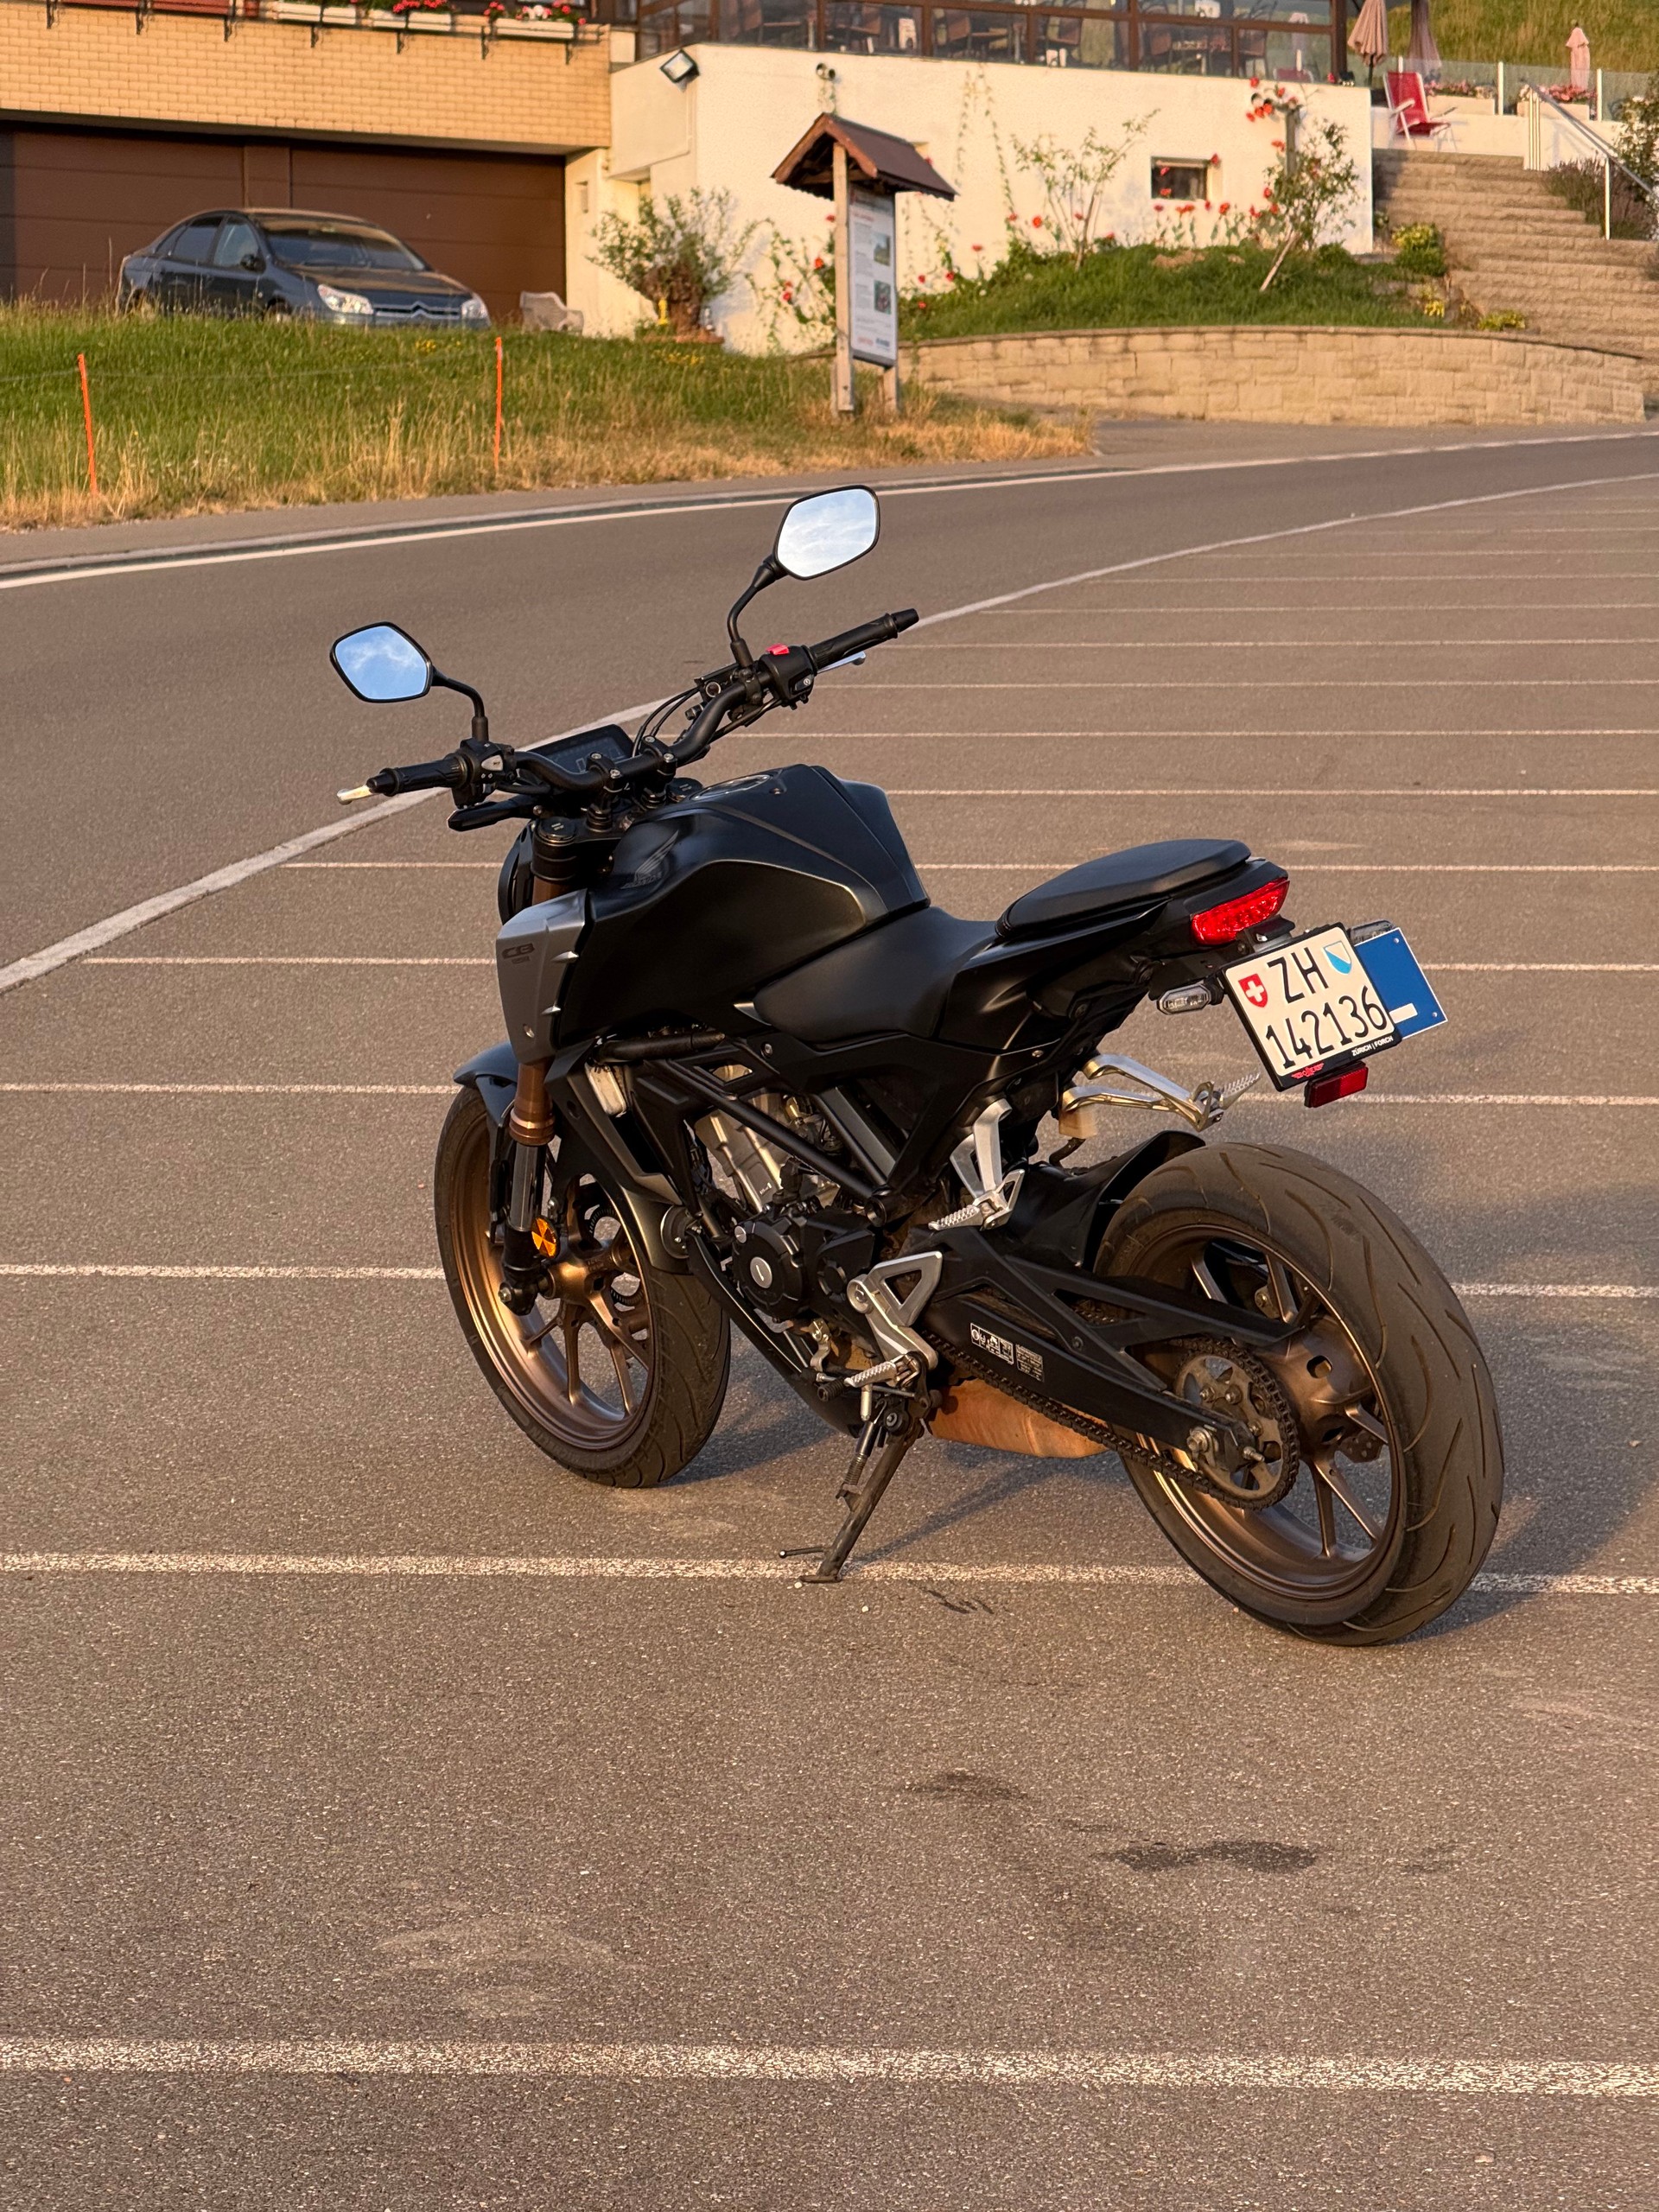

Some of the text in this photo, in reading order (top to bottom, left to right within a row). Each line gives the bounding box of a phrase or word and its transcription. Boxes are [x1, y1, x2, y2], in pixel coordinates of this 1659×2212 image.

[502, 943, 535, 959] CB
[1267, 947, 1329, 1004] ZH
[1266, 985, 1388, 1069] 142136
[1374, 1036, 1394, 1048] FORCH
